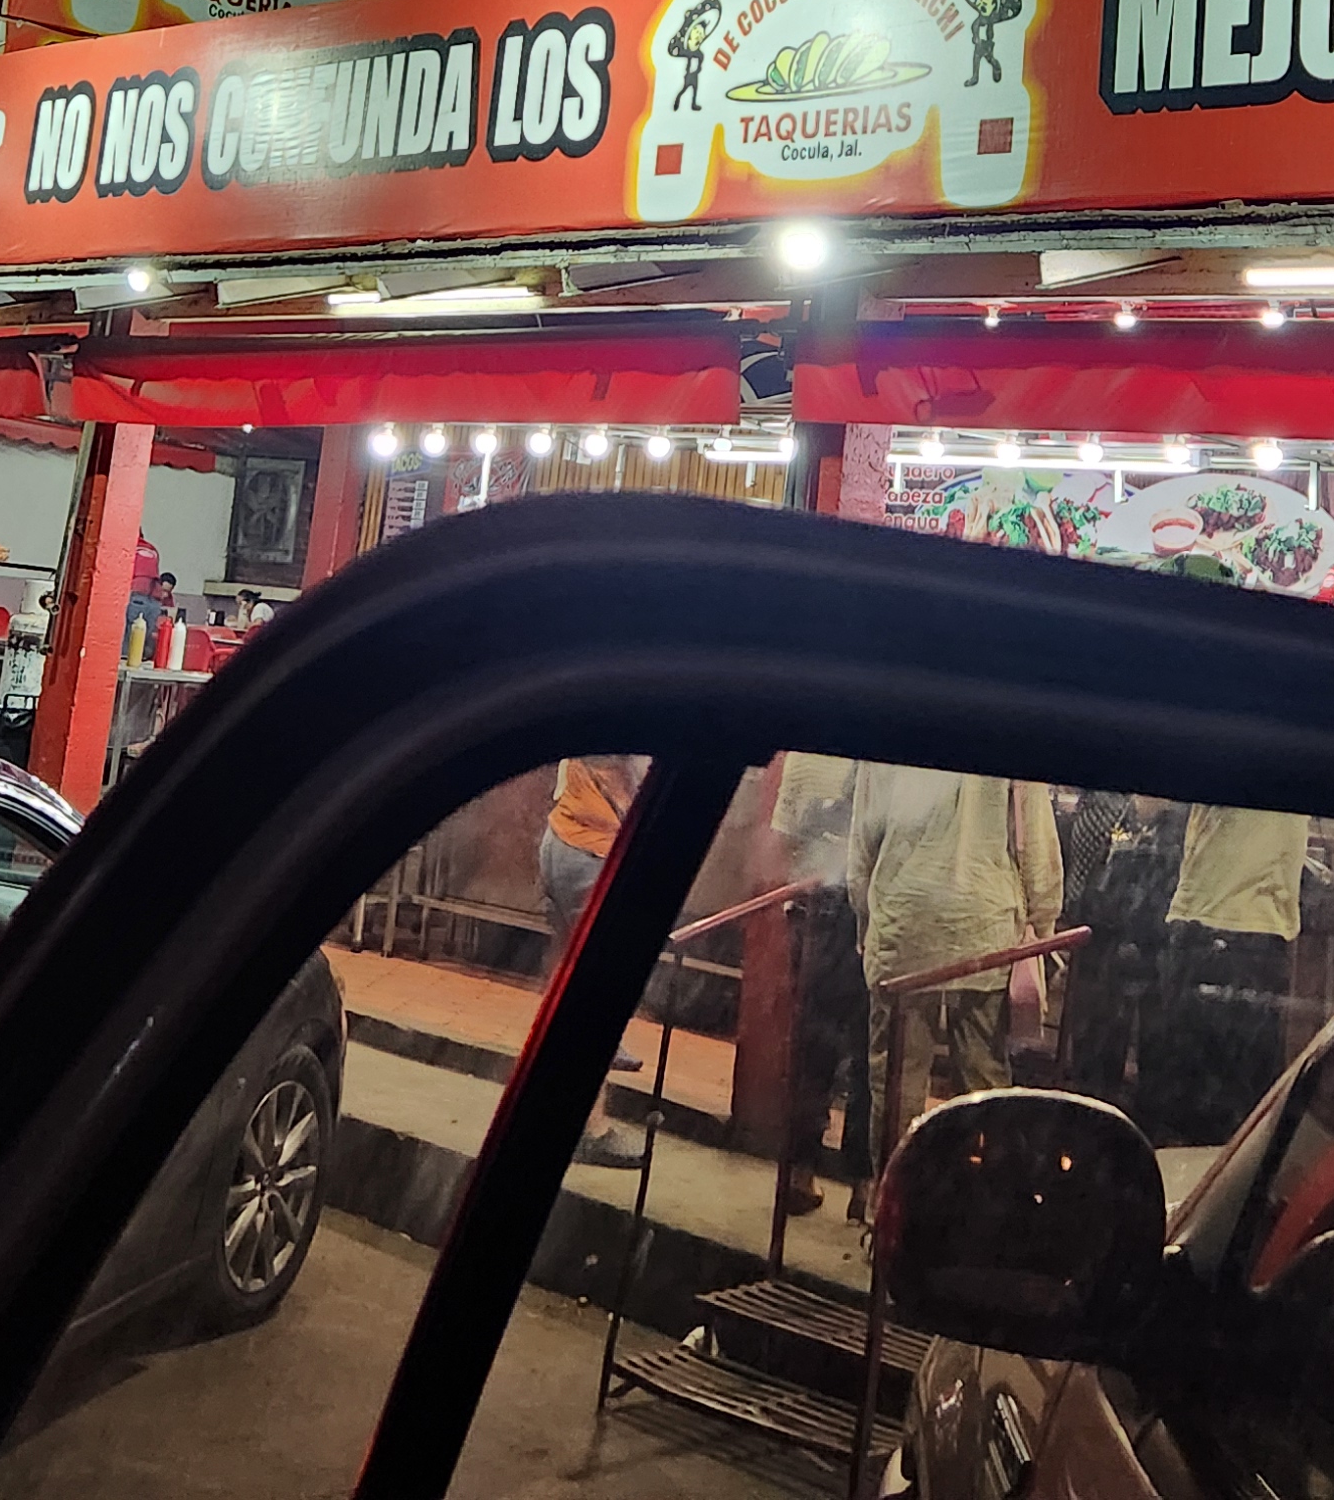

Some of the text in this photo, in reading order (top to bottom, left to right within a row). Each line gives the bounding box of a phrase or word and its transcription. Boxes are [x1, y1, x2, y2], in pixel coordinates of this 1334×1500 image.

[713, 36, 742, 72] DE
[27, 93, 91, 194] NO
[98, 80, 193, 188] NOS
[493, 22, 606, 148] LOS
[739, 102, 912, 145] TAQUERIAS
[780, 138, 863, 163] Cocula, Jal.
